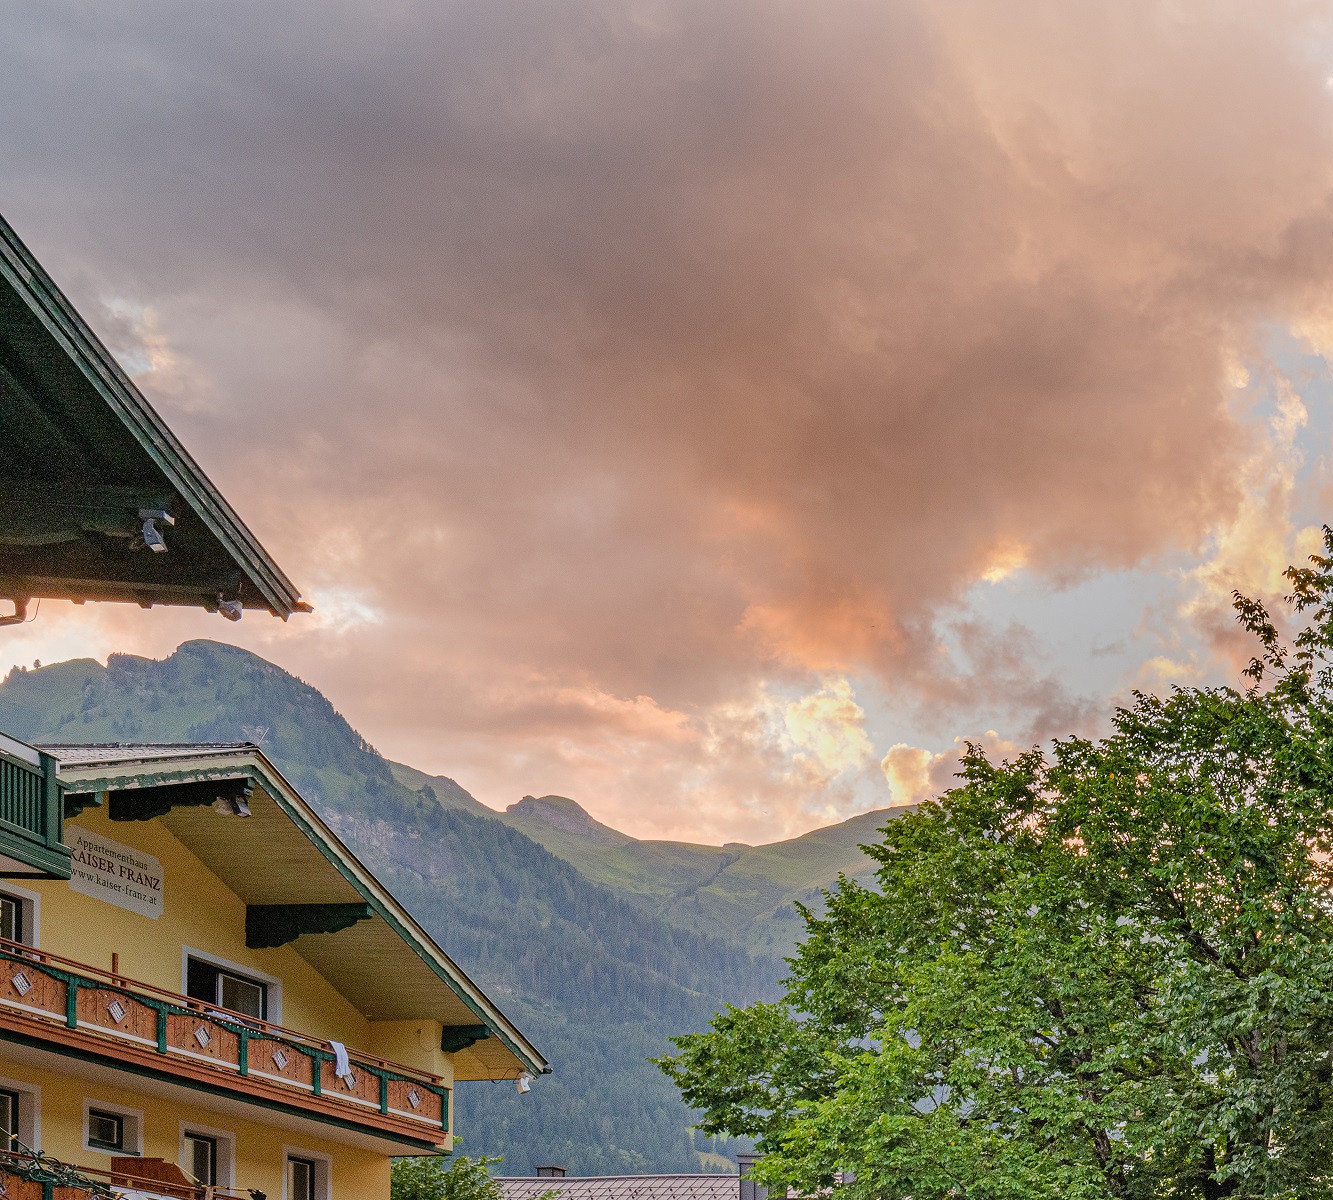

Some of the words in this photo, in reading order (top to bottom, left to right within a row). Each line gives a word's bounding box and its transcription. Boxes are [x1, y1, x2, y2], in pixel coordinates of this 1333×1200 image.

[69, 847, 116, 875] KAISER
[118, 865, 161, 891] FRANZ
[77, 836, 148, 871] Appartementhaus
[71, 868, 157, 906] www.kaiser-franz.at
